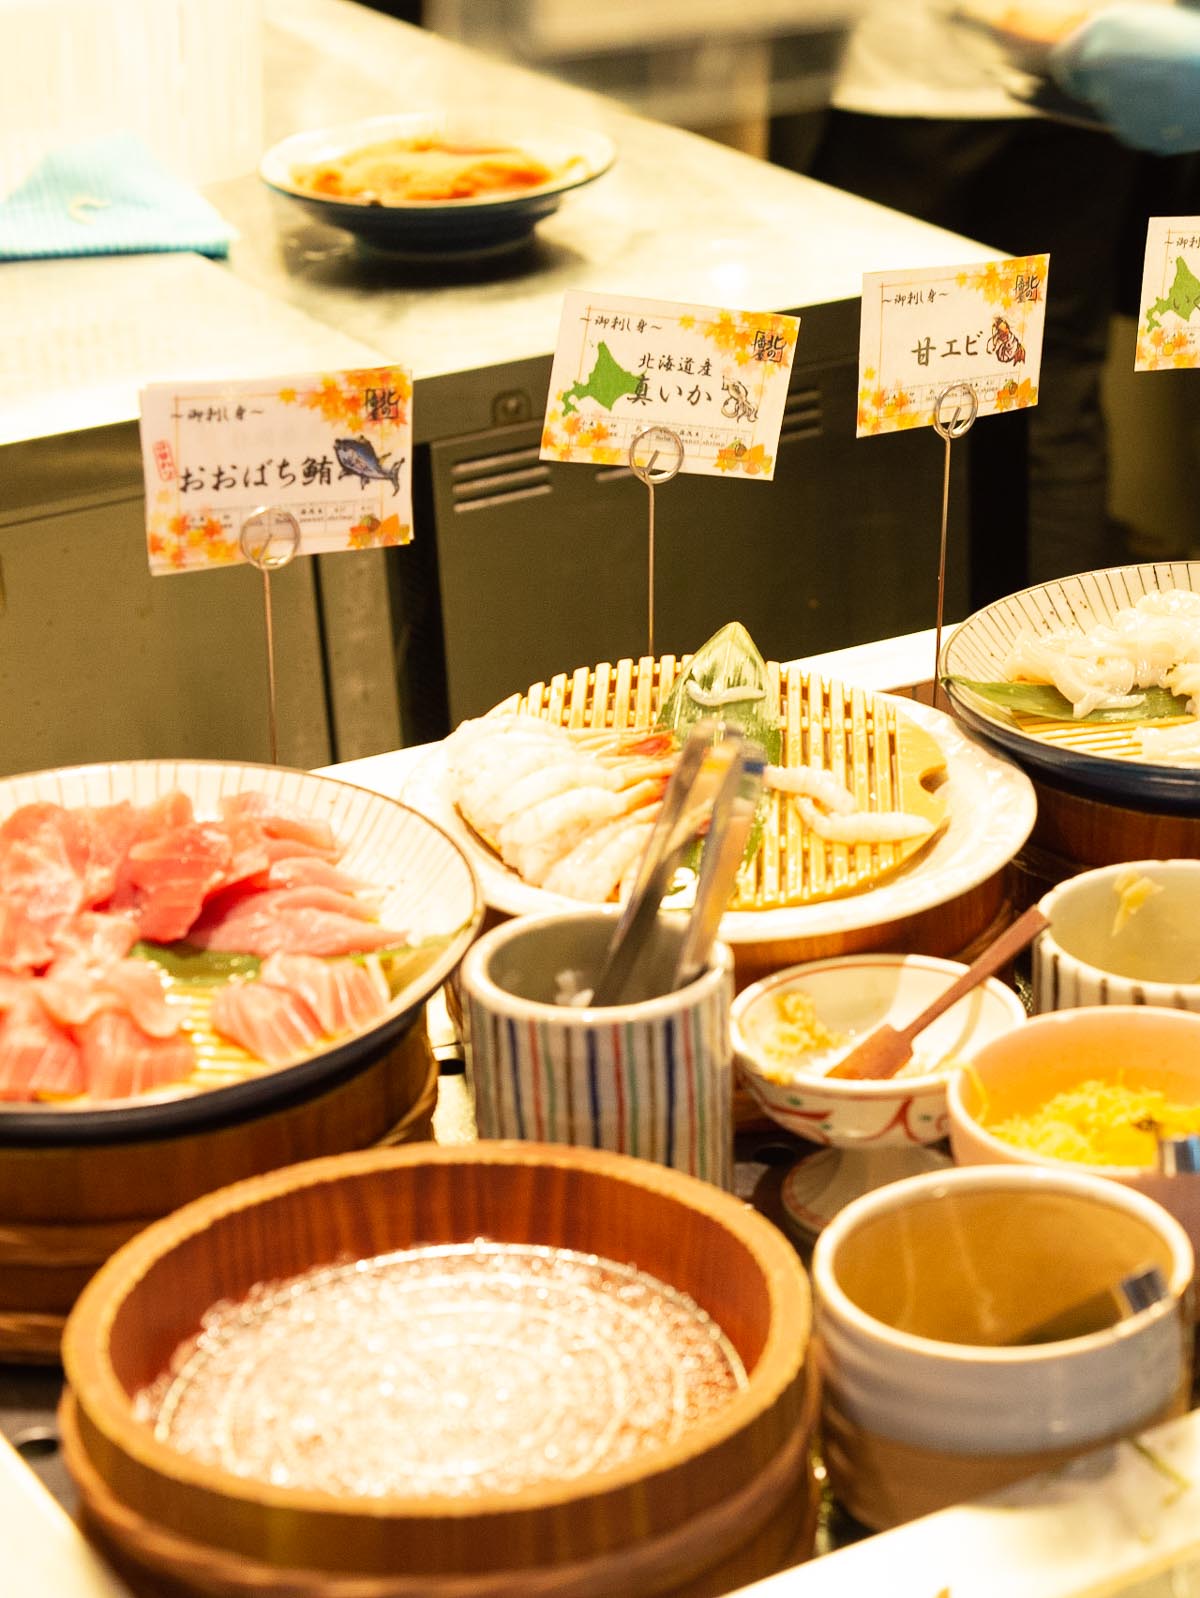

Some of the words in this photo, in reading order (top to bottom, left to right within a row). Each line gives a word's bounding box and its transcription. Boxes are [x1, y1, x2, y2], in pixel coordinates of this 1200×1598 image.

[638, 353, 713, 377] 北海道産
[911, 331, 984, 367] 甘エビ
[627, 374, 712, 406] 真いか
[180, 455, 333, 492] おおばち鮪
